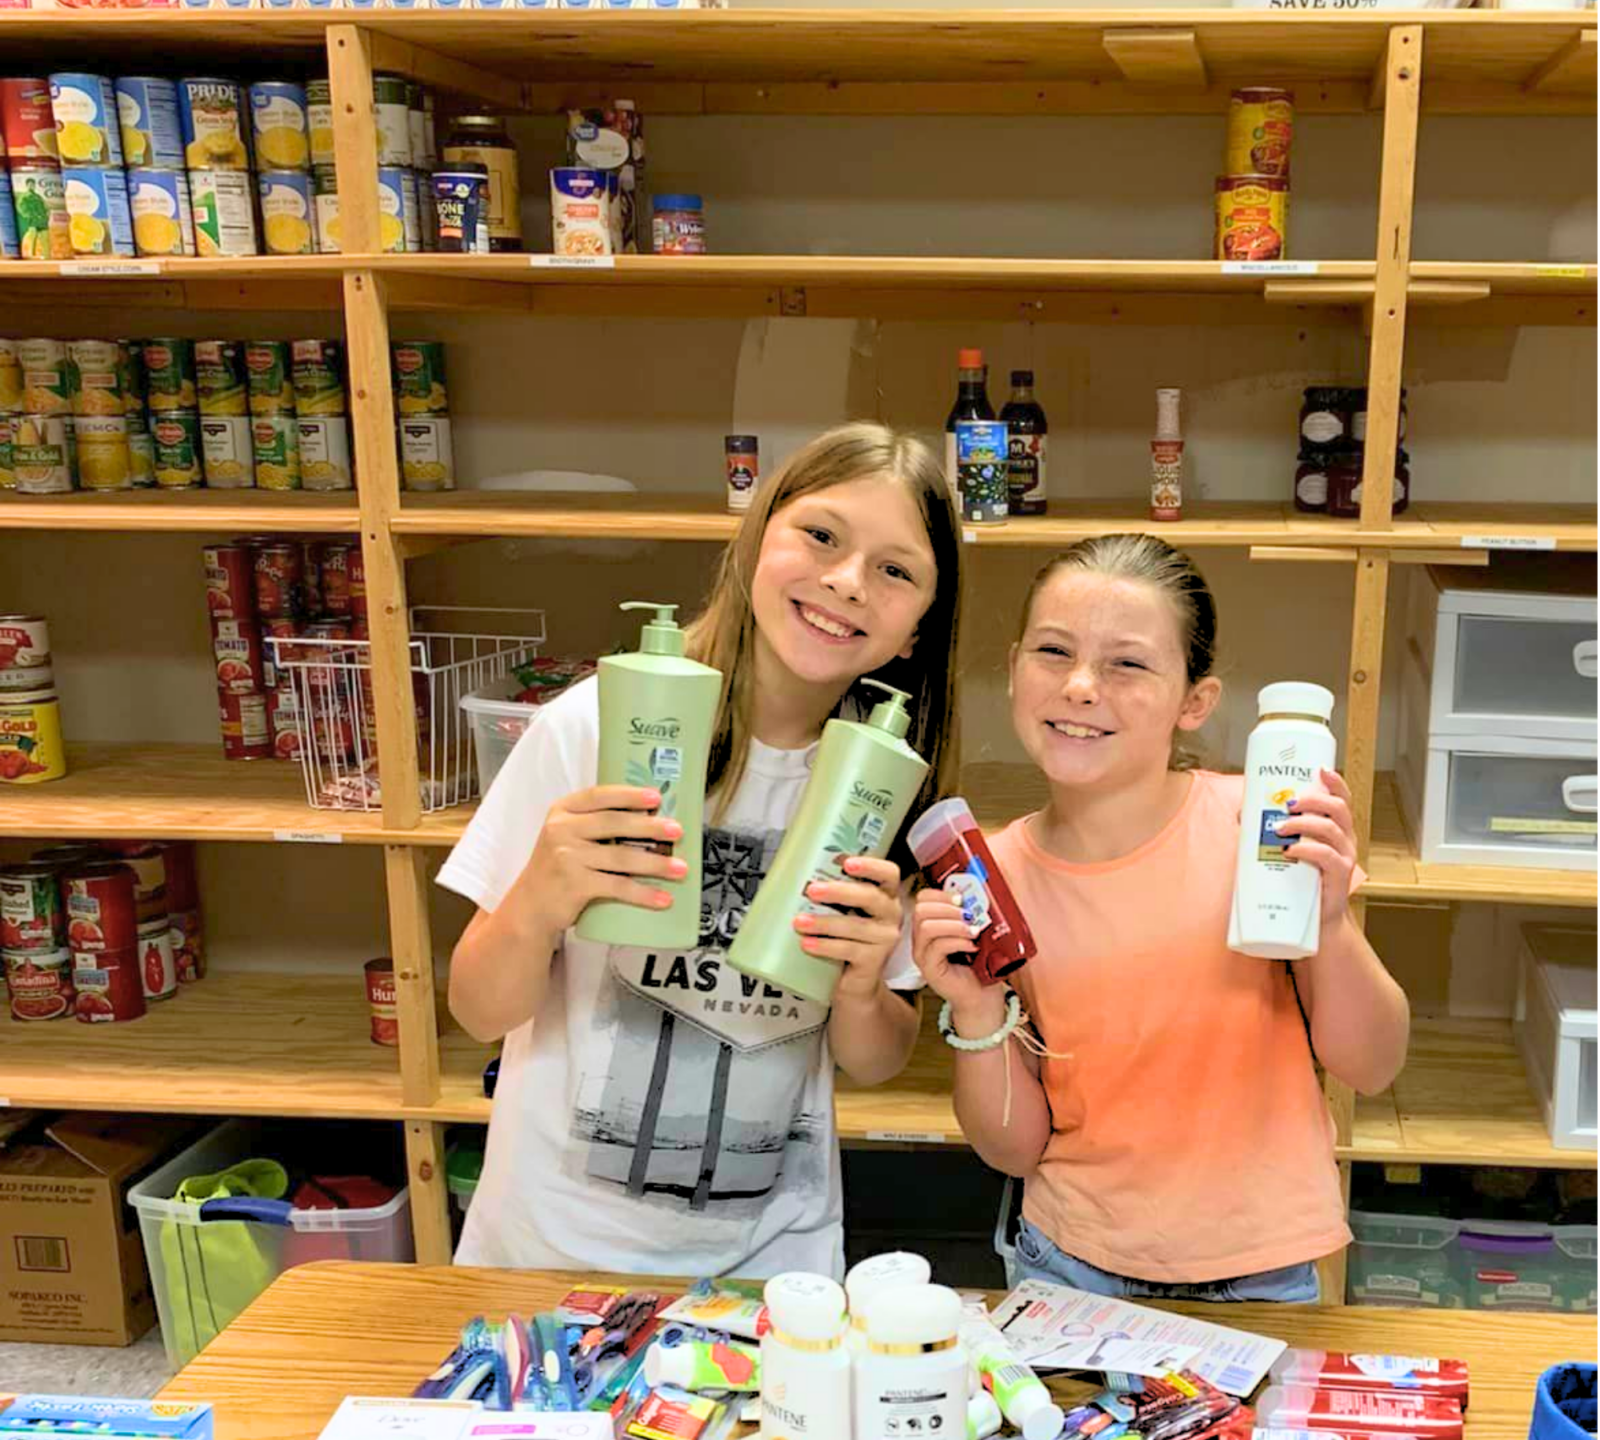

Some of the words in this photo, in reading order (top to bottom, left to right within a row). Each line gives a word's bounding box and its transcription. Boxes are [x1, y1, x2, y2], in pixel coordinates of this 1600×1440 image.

[1270, 0, 1326, 9] SAVE
[187, 83, 238, 103] PRIDE
[215, 639, 249, 652] TOMATO
[2, 720, 38, 732] GOLD
[630, 717, 680, 739] Suave
[1258, 765, 1313, 779] PANTENE
[850, 780, 893, 812] Suave
[640, 953, 721, 993] LAS
[703, 998, 799, 1020] NEVADA
[21, 1184, 77, 1194] PREPARED
[762, 1399, 808, 1429] PANTENE
